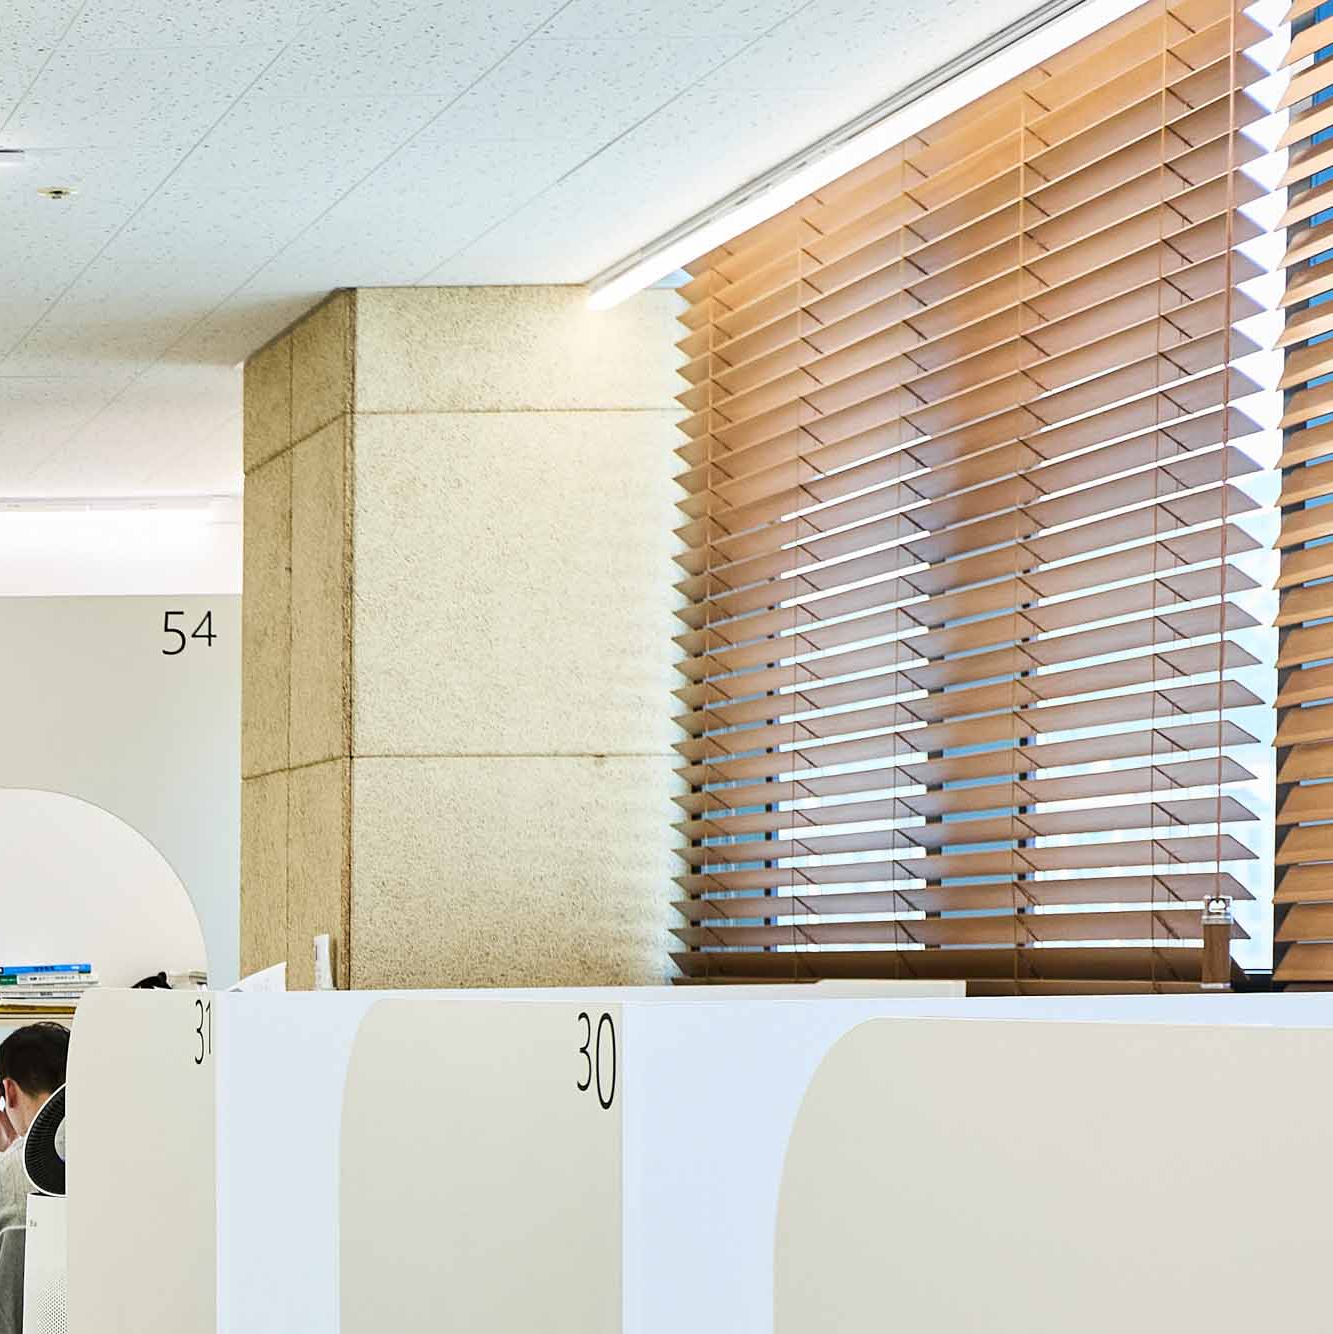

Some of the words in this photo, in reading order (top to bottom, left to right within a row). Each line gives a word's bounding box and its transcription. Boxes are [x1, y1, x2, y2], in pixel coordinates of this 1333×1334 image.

[162, 610, 218, 656] 54
[194, 999, 212, 1065] 31
[576, 1011, 617, 1110] 30
